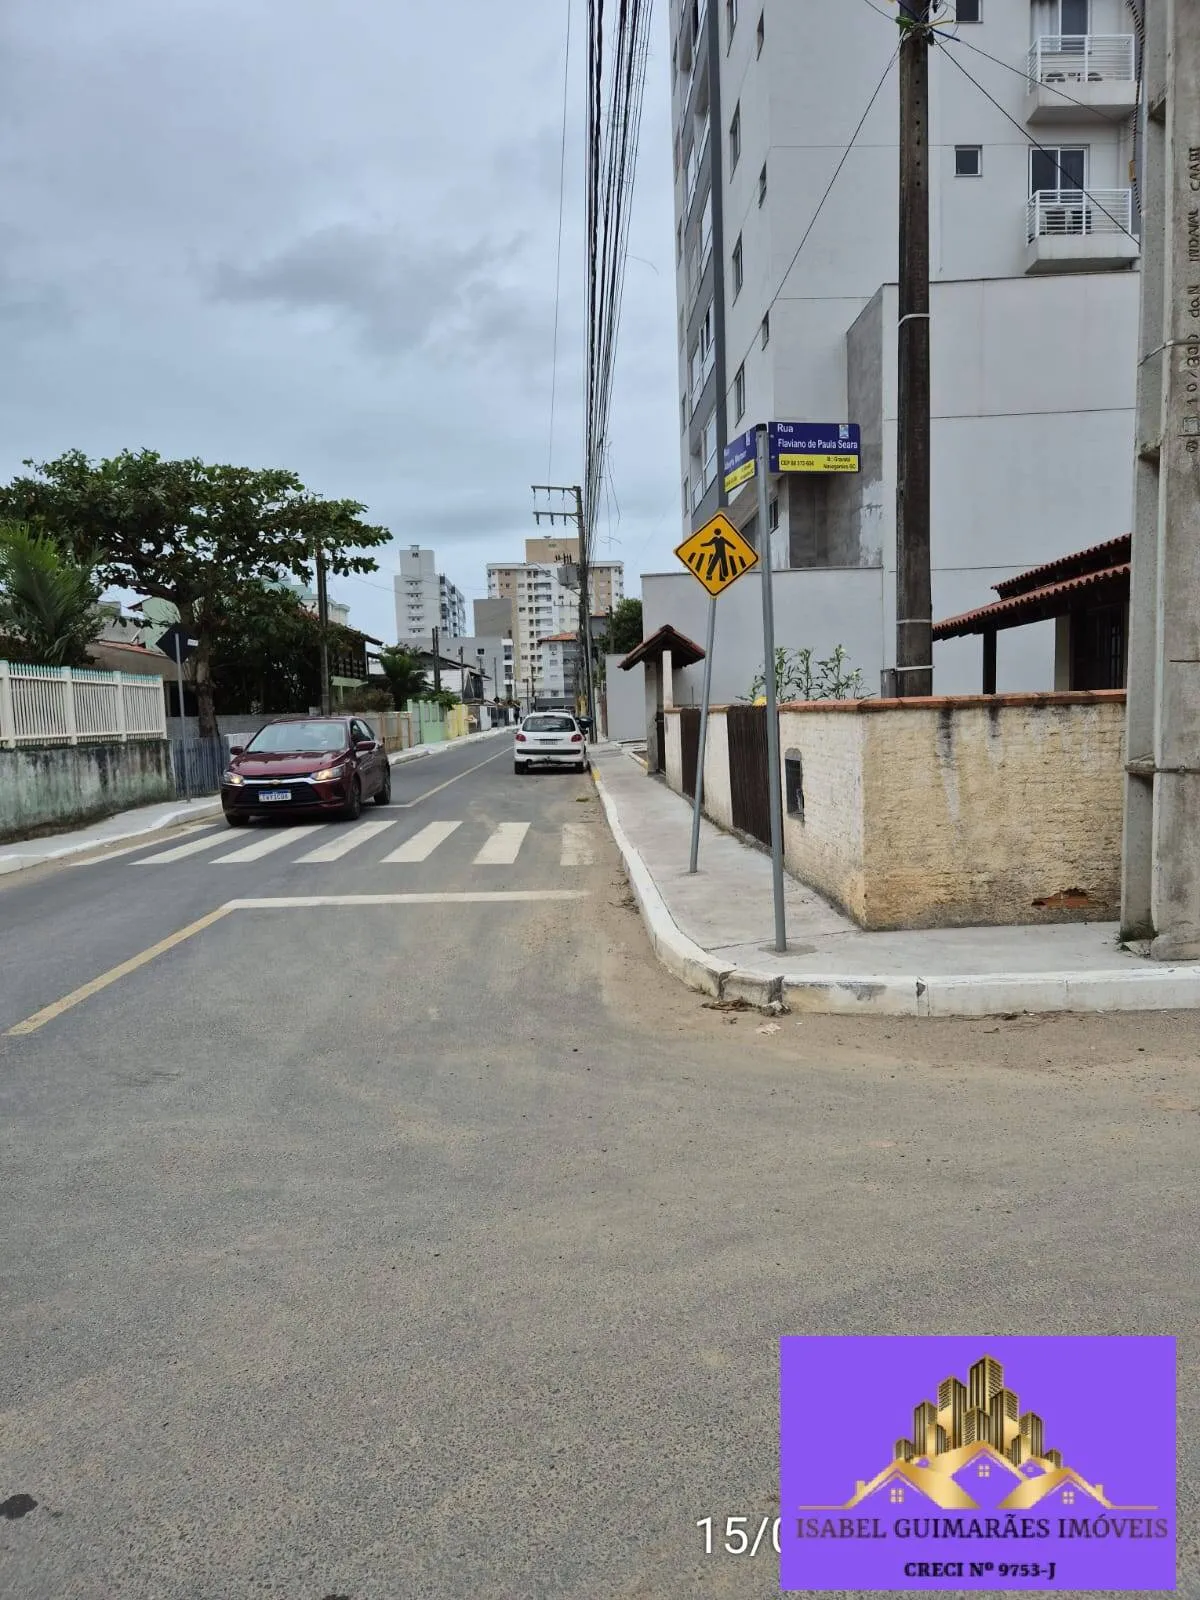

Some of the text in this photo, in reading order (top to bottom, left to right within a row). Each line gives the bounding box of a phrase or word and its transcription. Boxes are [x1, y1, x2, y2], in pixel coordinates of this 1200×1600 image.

[777, 424, 794, 433] Rua
[777, 438, 858, 449] Flaviano de Paula Seara
